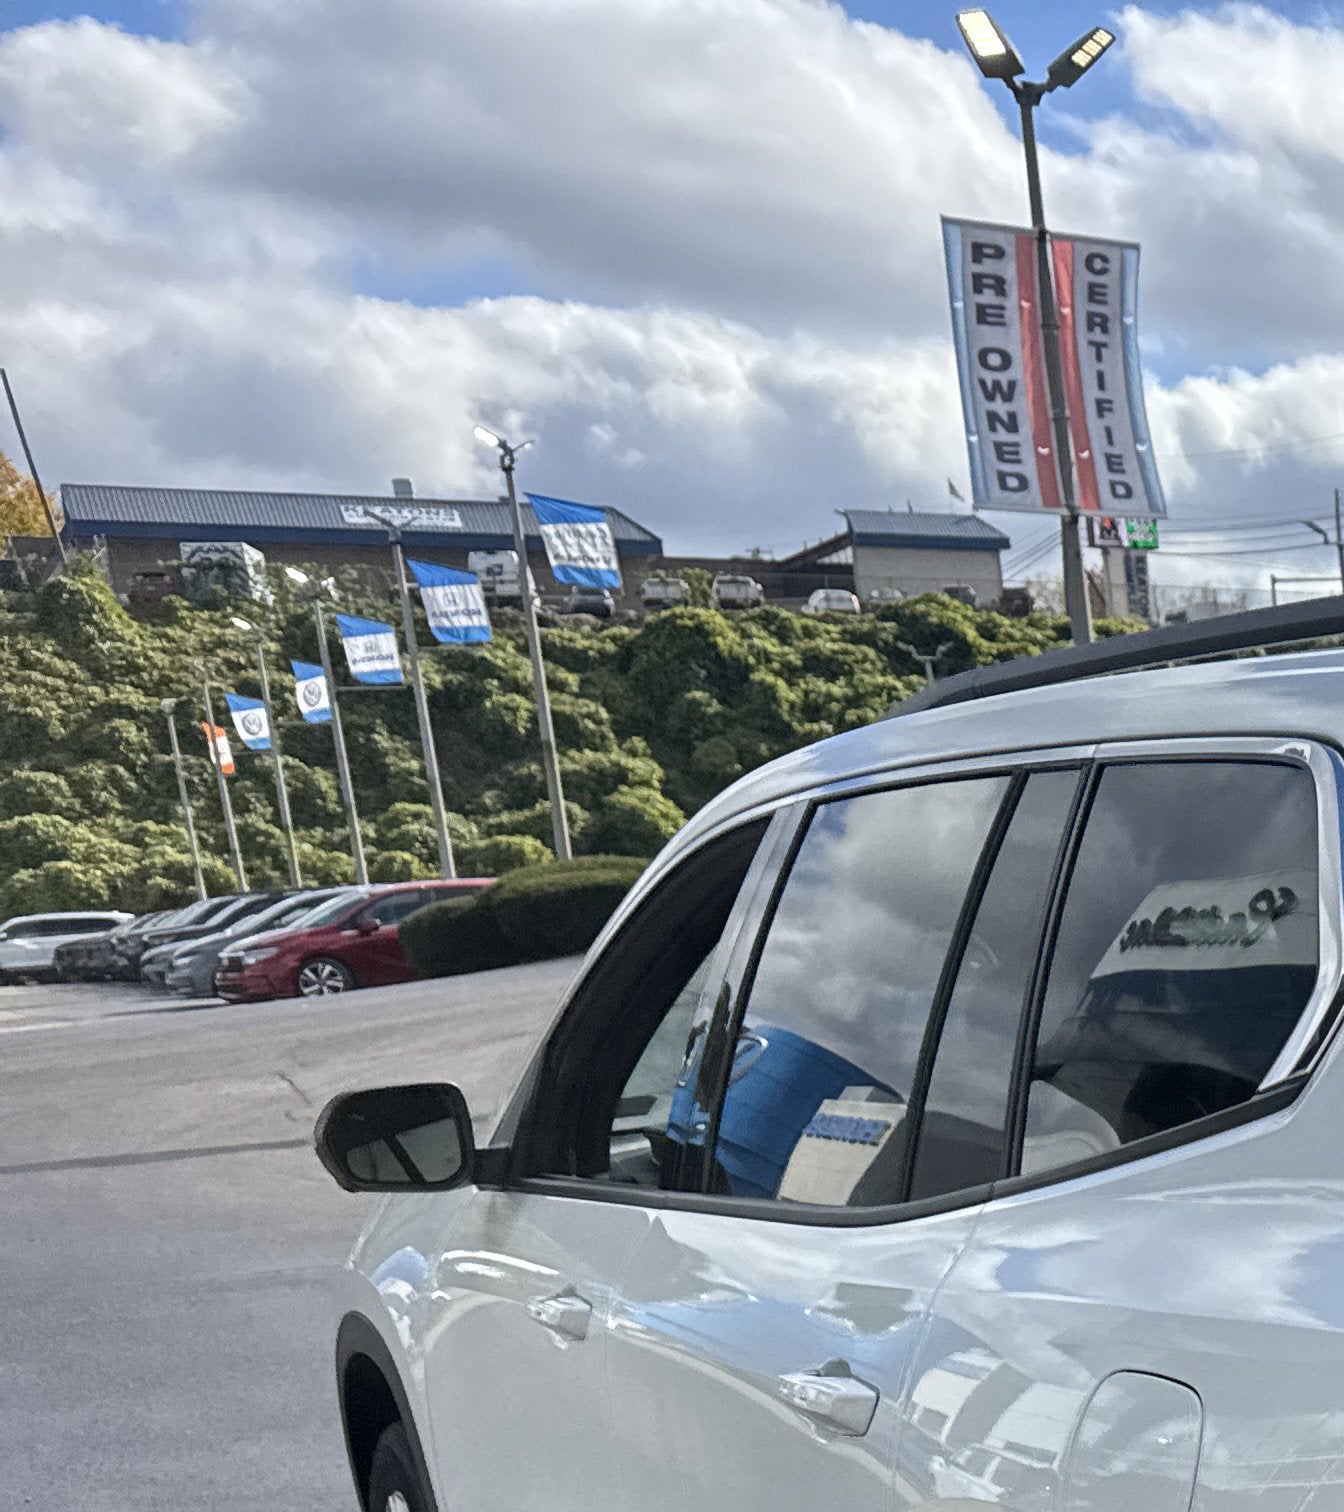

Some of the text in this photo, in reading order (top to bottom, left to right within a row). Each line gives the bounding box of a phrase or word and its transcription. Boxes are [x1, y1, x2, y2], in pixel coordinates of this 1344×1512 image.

[970, 241, 1030, 493] PRE OWNED
[1084, 252, 1133, 500] CERTIFIED
